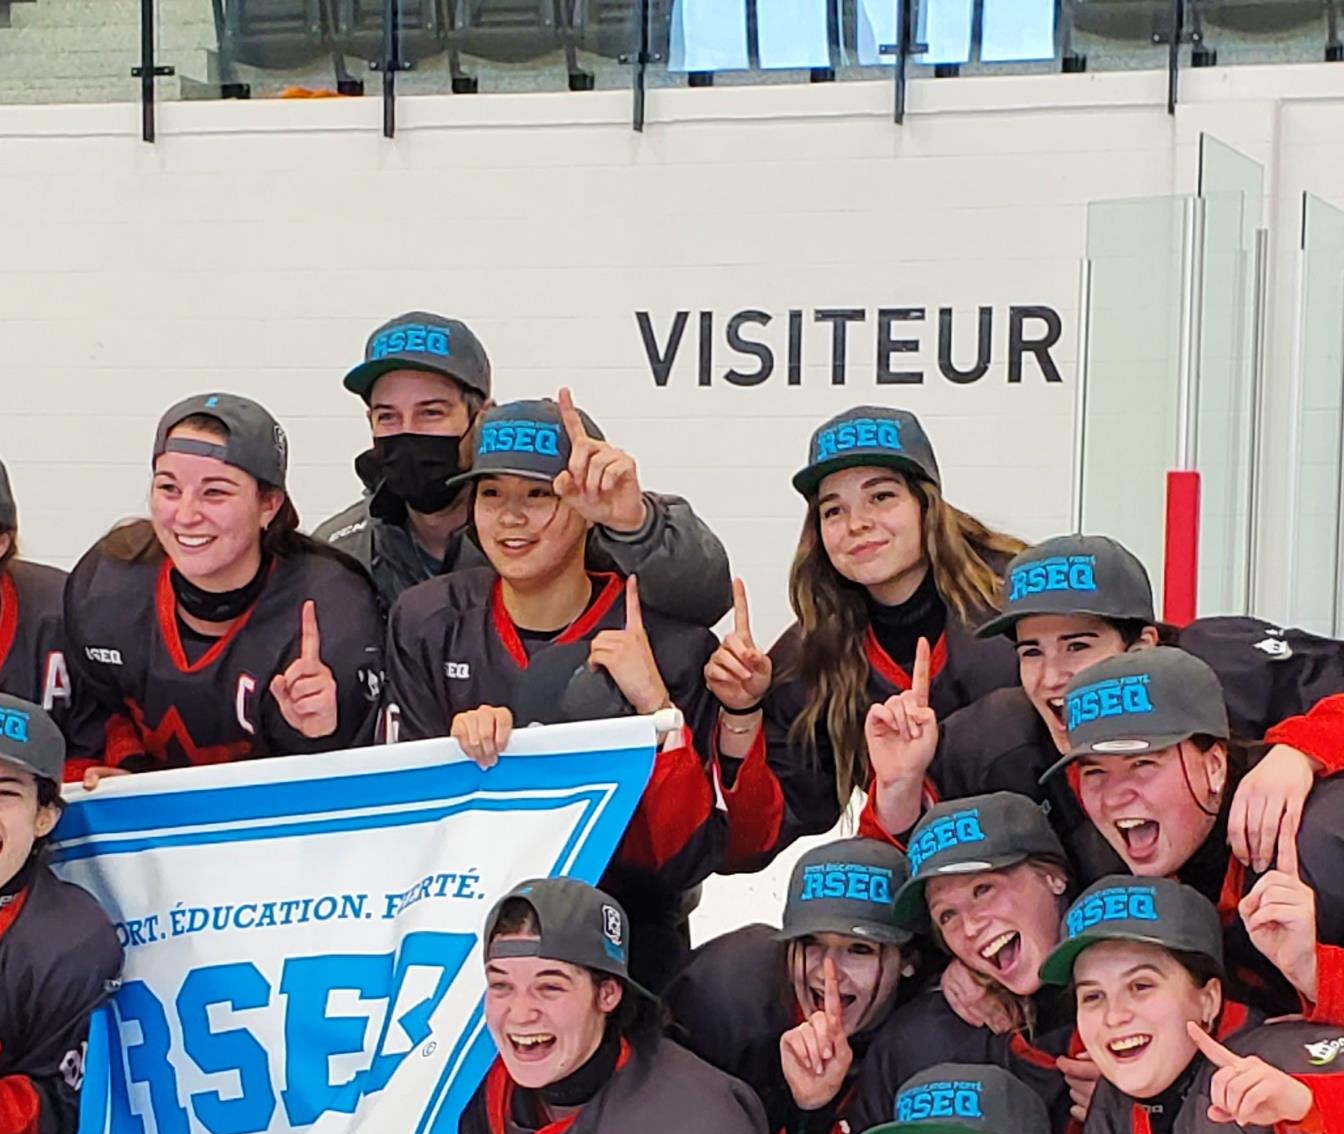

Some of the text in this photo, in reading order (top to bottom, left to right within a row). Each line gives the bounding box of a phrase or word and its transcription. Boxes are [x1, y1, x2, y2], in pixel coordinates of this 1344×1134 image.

[635, 305, 1064, 387] VISITEUR
[479, 427, 560, 457] RSEQ
[1009, 562, 1097, 602] RSEQ
[42, 651, 72, 711] A
[1067, 682, 1153, 727] RSEQ
[801, 870, 894, 904] RSEQ
[171, 894, 372, 936] ÉDUCATION.
[1065, 893, 1158, 940] RSEQ
